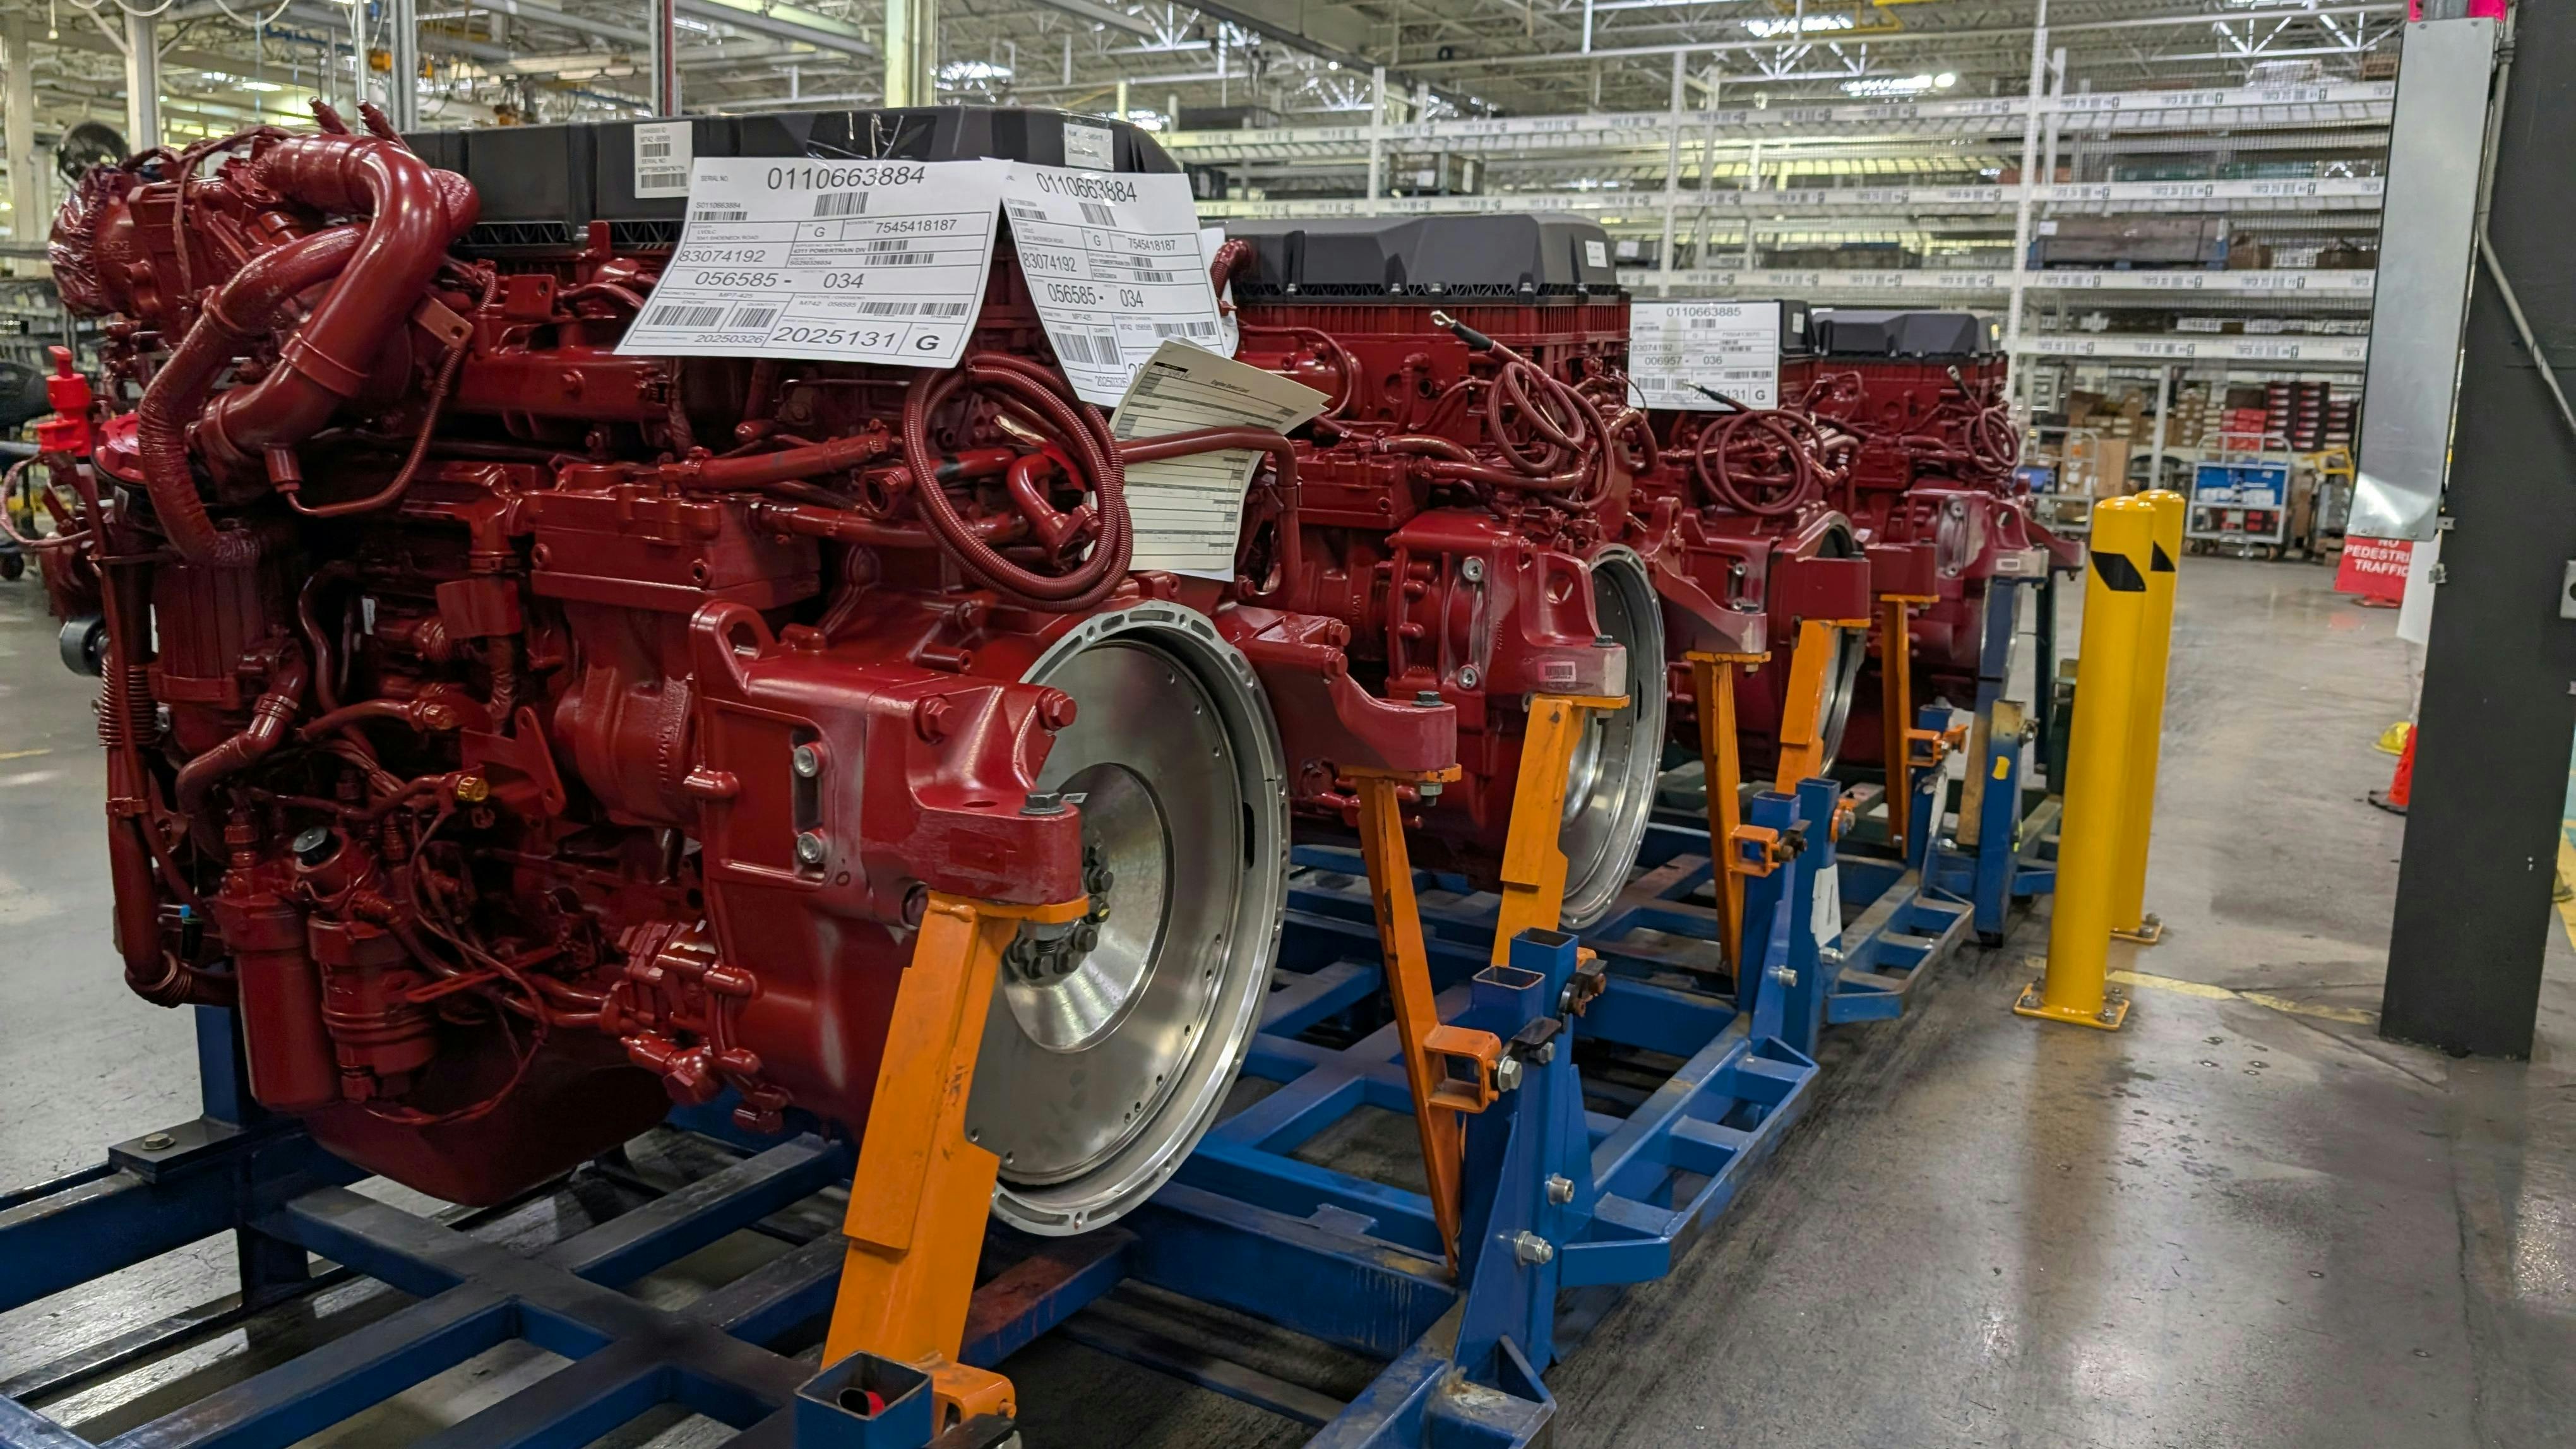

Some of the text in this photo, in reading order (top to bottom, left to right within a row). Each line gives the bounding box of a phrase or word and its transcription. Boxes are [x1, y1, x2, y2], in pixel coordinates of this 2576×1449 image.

[767, 166, 925, 190] 0110663884
[1036, 172, 1137, 202] 0110663884
[814, 227, 825, 237] G
[876, 219, 957, 234] 7545418187
[1094, 235, 1101, 246] G
[1128, 237, 1176, 251] 7545418187
[679, 250, 765, 263] 83074192
[1022, 252, 1077, 273] 83074192
[695, 271, 778, 287] 056585
[823, 273, 864, 289] 034
[1047, 283, 1096, 305] 056585
[1120, 289, 1144, 308] 034
[1666, 307, 1741, 317] 0110663885
[694, 335, 765, 343] 20250326
[772, 326, 896, 348] 2025131
[915, 335, 940, 350] G
[1645, 356, 1683, 366] 006957
[1703, 356, 1722, 366] 036
[1693, 389, 1746, 400] 20131
[1755, 390, 1766, 400] G
[2378, 539, 2400, 548] NO
[2344, 544, 2410, 563] PEDESTRI
[2355, 559, 2409, 577] TRAFFIC
